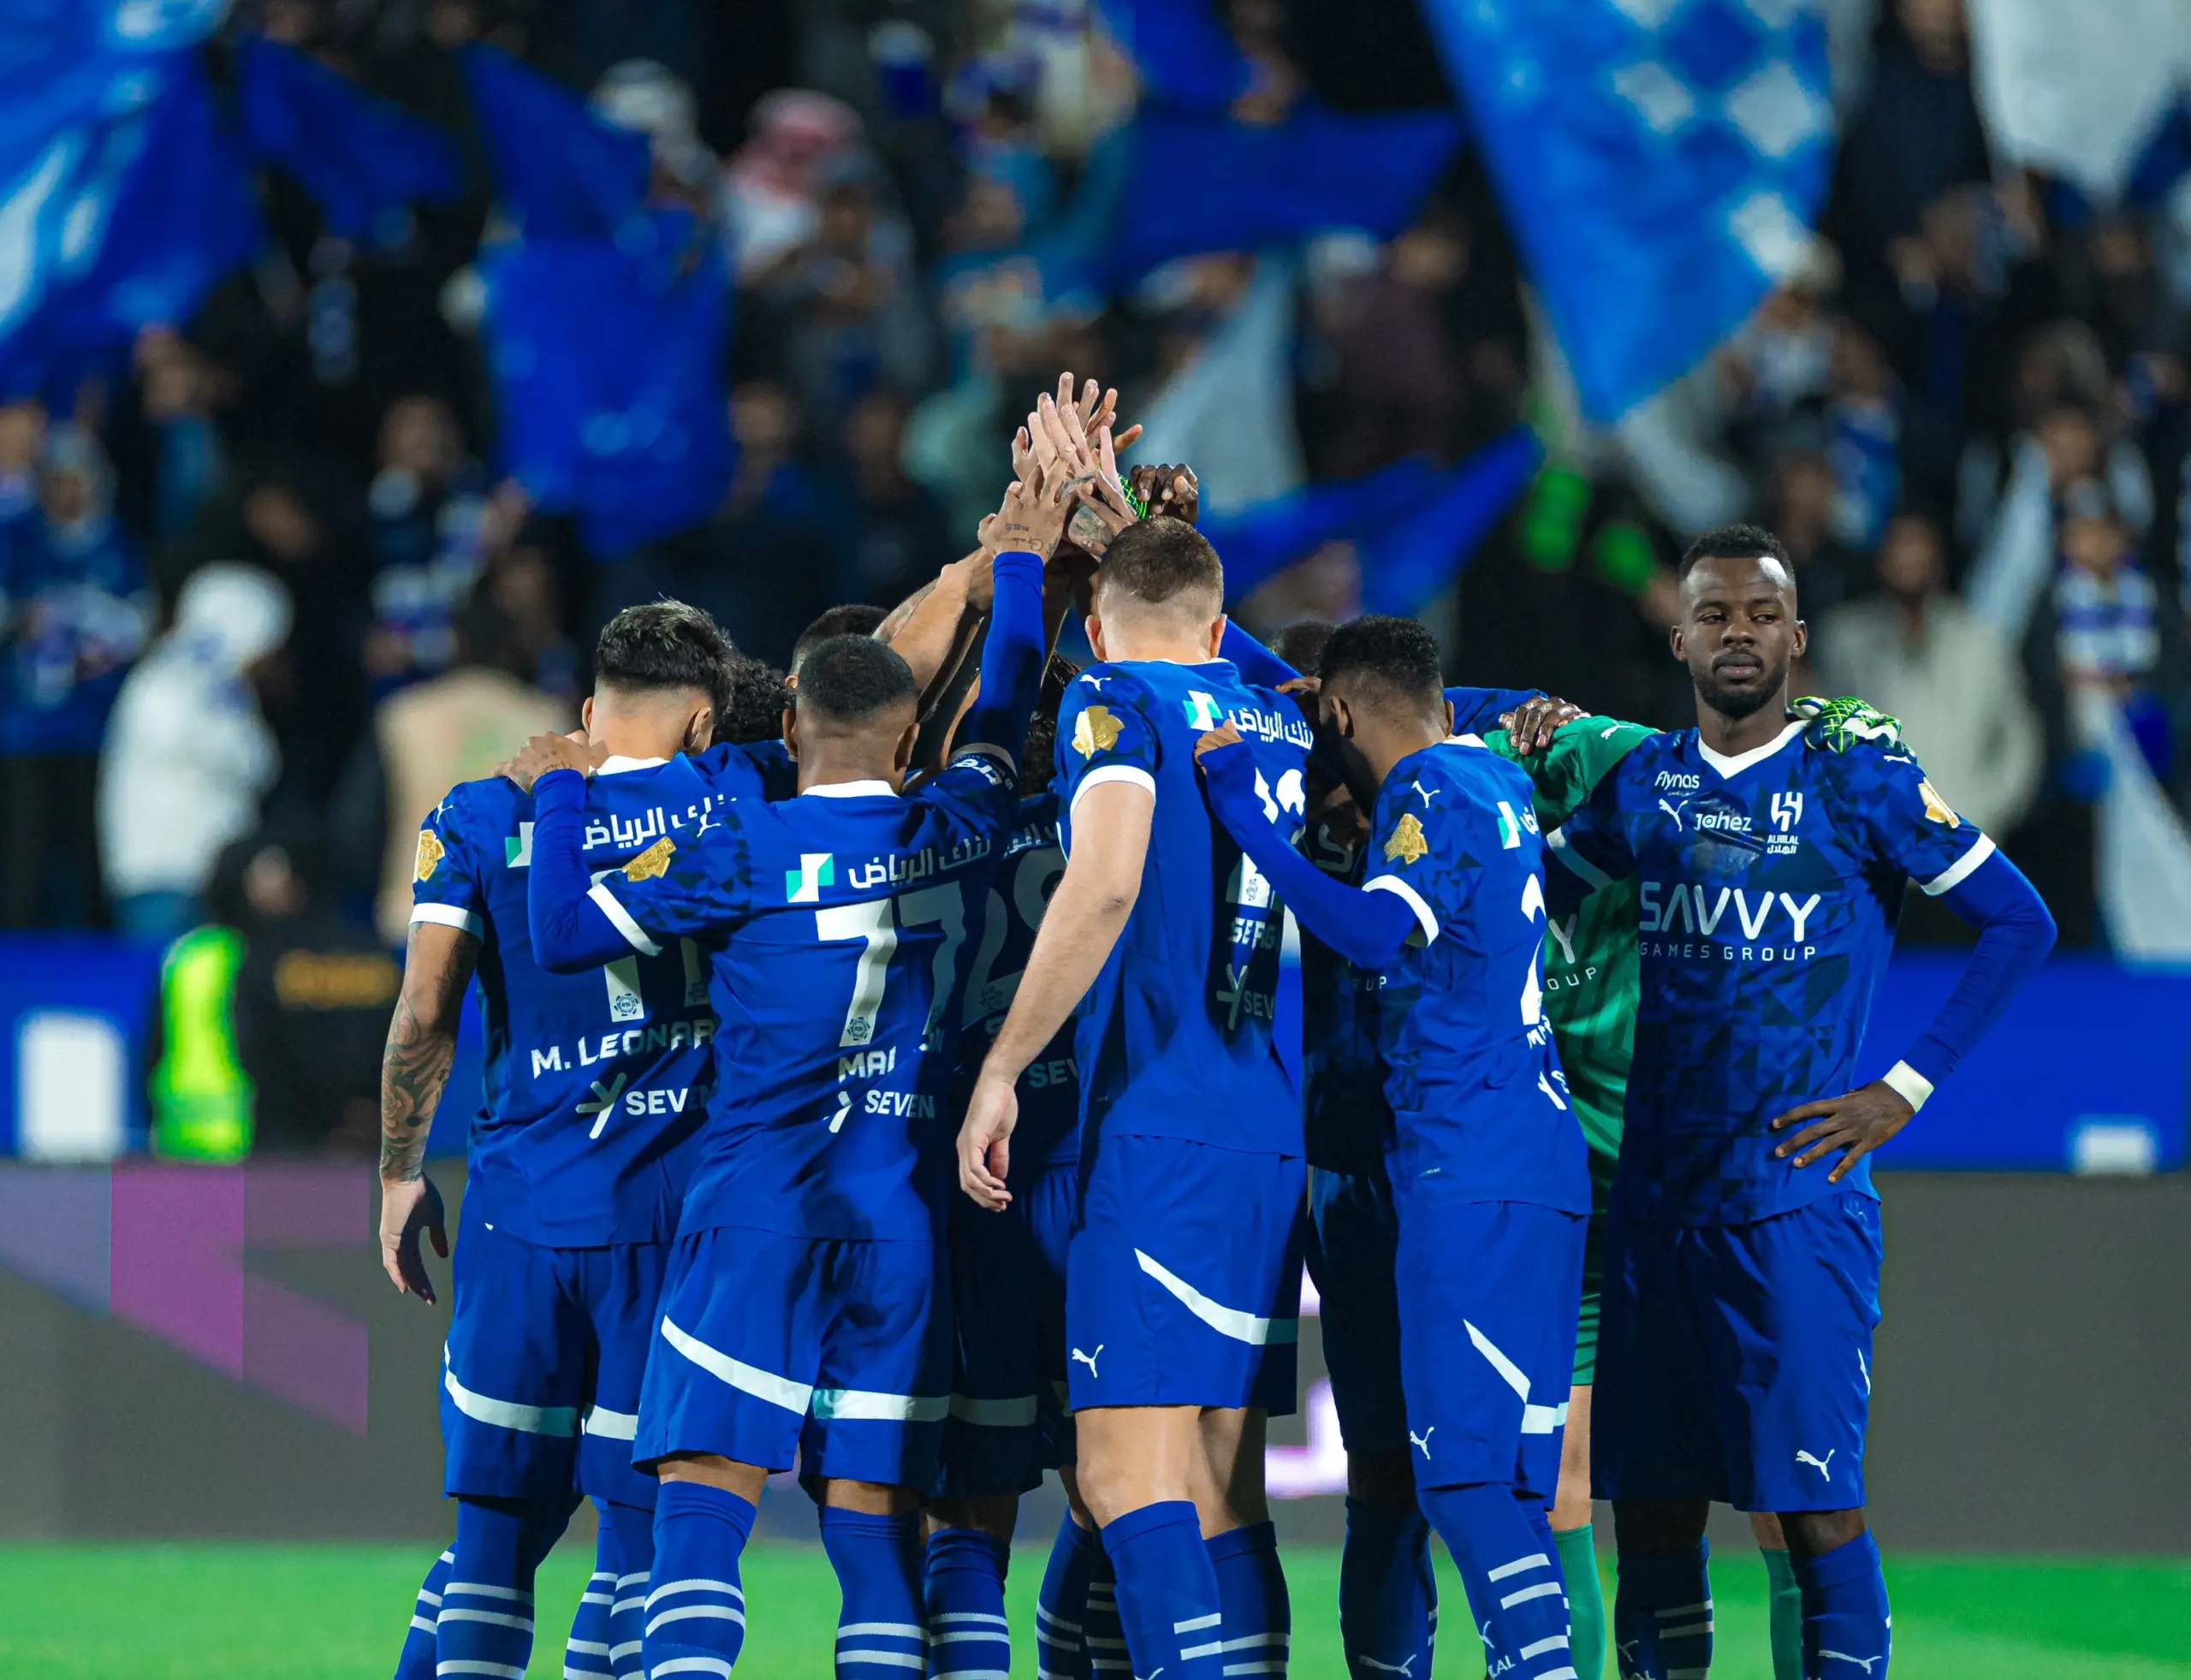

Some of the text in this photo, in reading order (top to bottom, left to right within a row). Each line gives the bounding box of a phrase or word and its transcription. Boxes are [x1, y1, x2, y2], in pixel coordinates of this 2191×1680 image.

[1227, 707, 1284, 743] الرياض
[1654, 770, 1701, 790] flynas
[1766, 834, 1800, 845] ALHILAL
[845, 847, 934, 889] الرياض
[1638, 881, 1822, 943] SAVVY
[815, 880, 967, 1048] 77
[1639, 941, 1816, 962] GAMES GROUP
[864, 1089, 935, 1119] SEVEN
